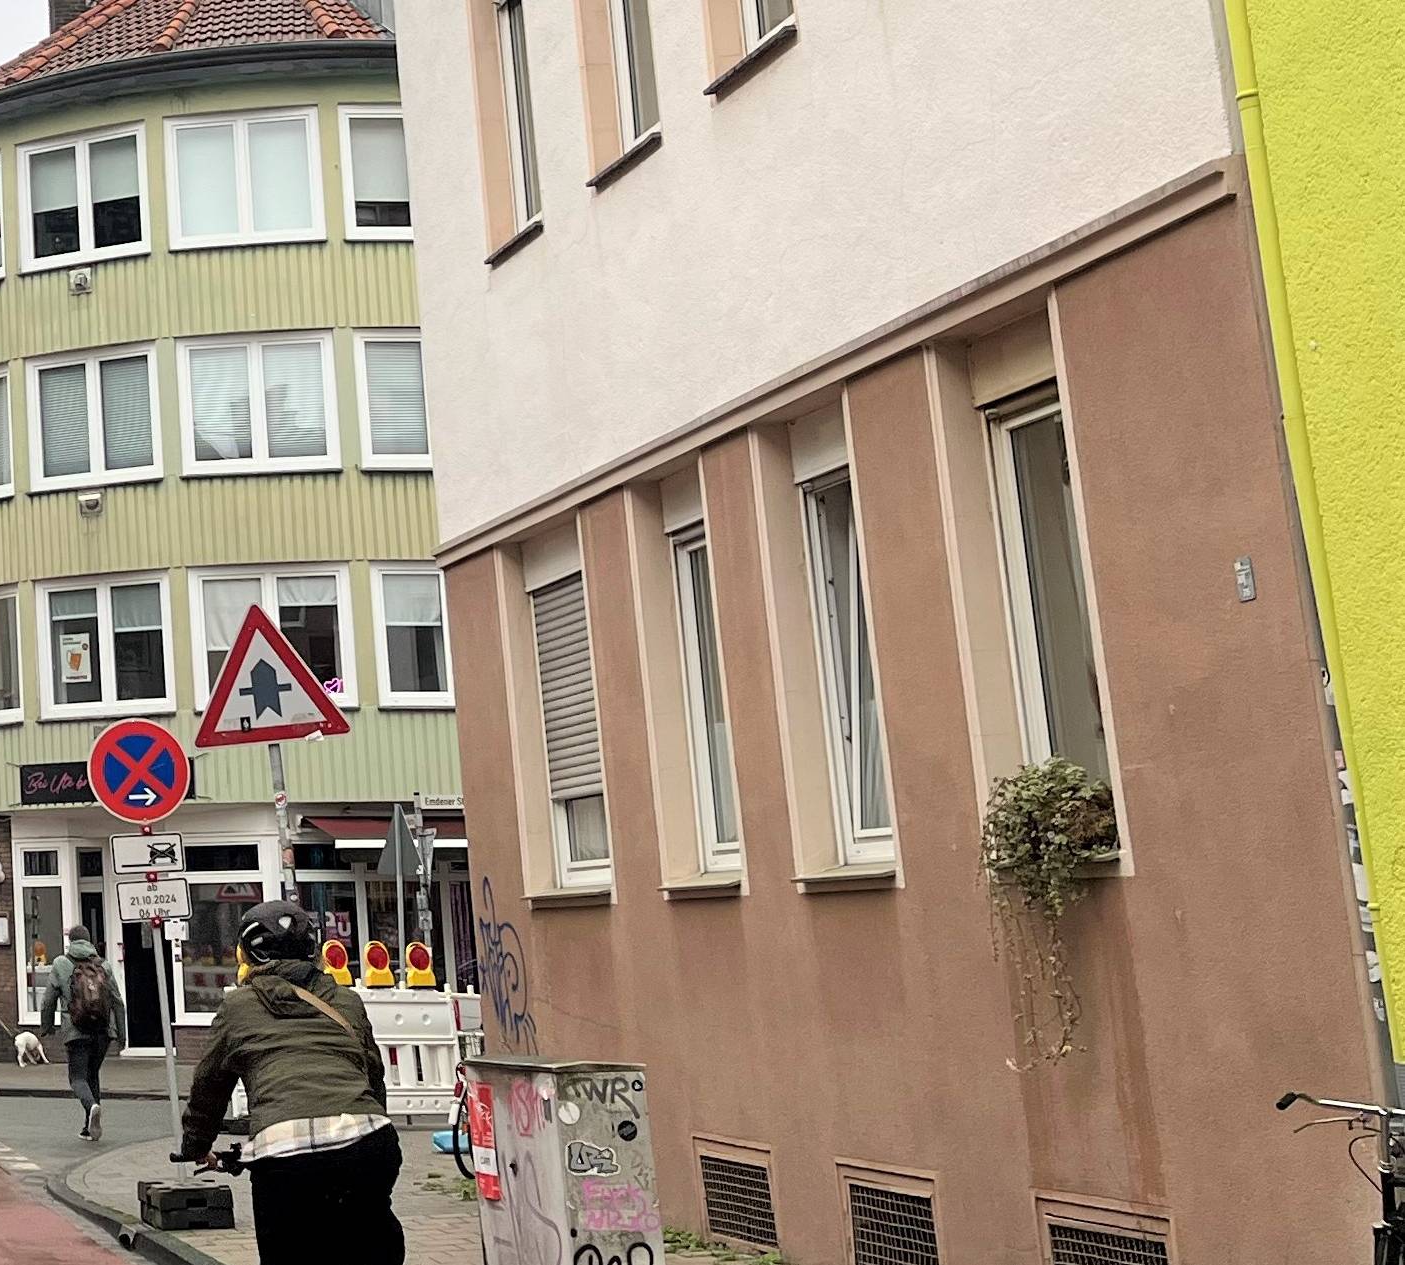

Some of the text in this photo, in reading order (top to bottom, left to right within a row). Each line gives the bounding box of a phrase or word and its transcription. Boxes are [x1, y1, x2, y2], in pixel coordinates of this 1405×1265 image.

[424, 797, 456, 806] Emdener
[147, 883, 158, 892] ab
[130, 894, 177, 906] 21.10.2024
[139, 908, 171, 919] 06 Uhr
